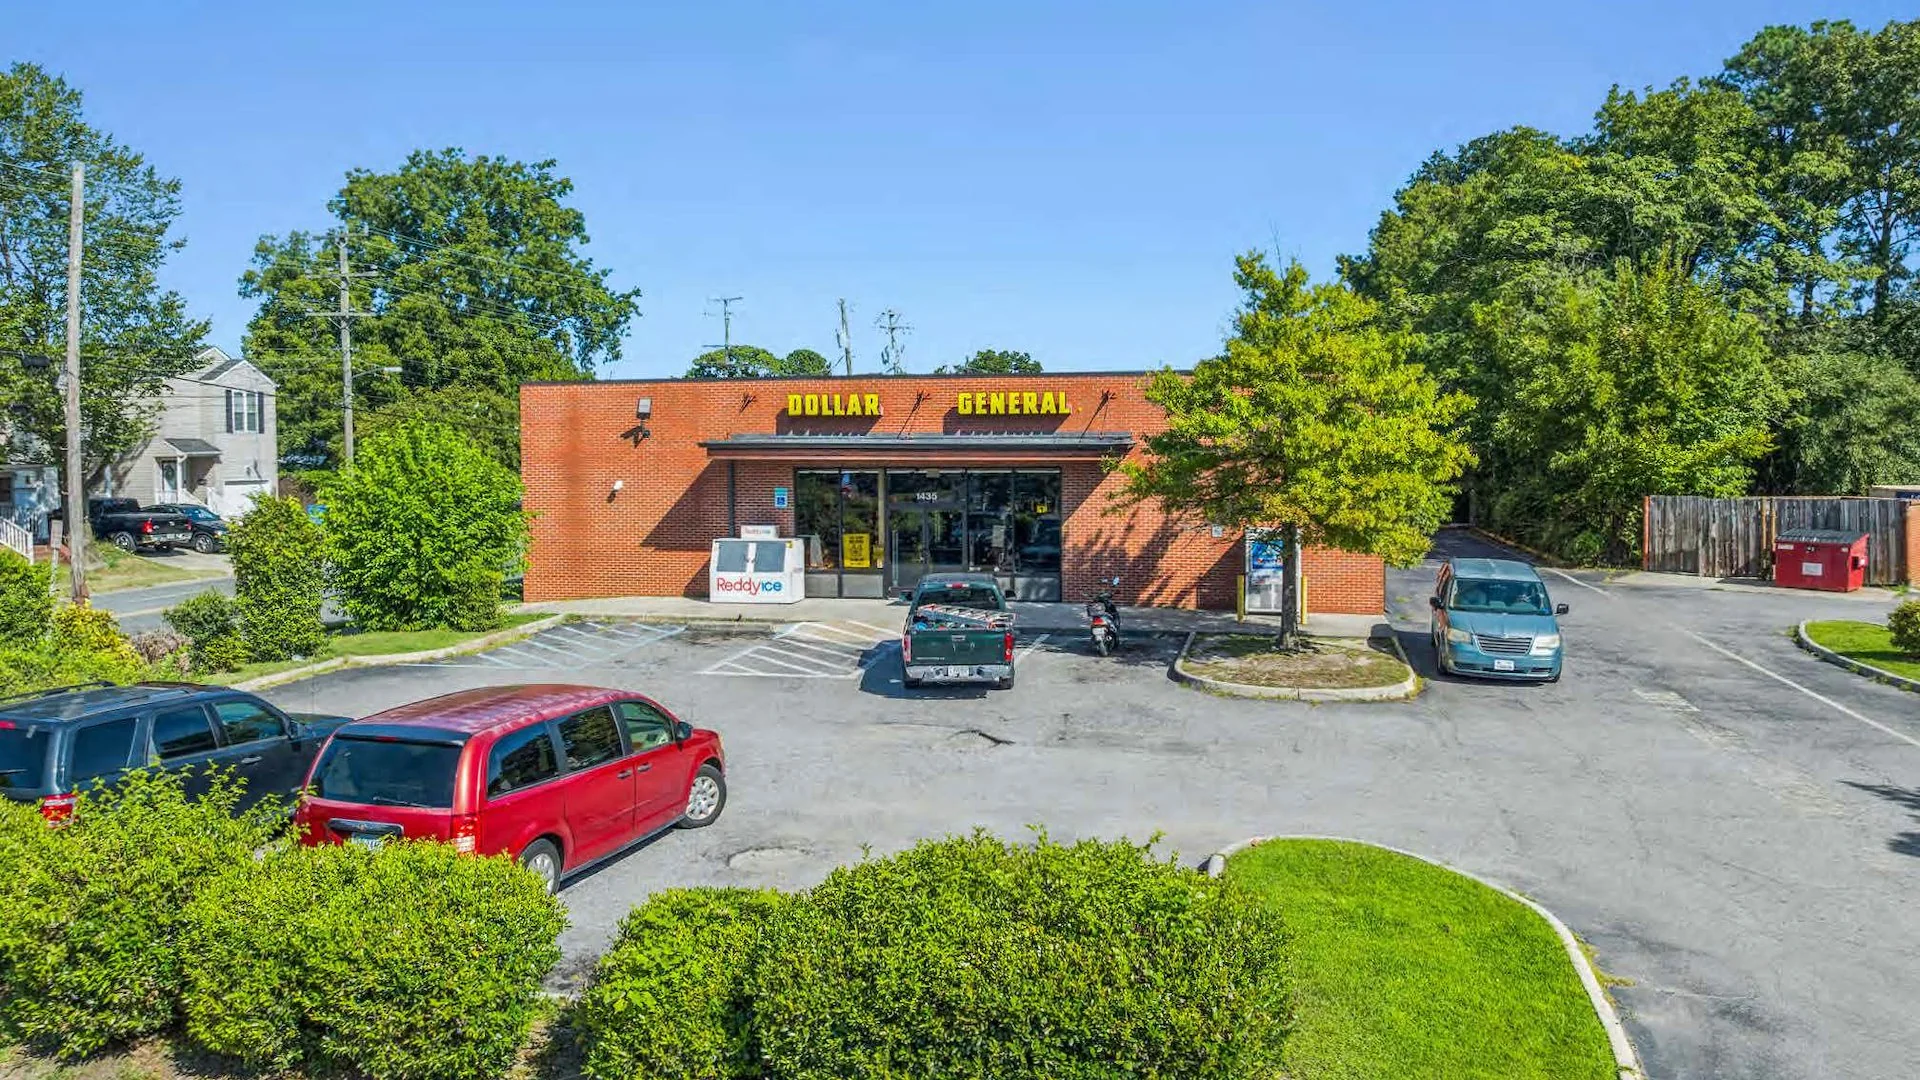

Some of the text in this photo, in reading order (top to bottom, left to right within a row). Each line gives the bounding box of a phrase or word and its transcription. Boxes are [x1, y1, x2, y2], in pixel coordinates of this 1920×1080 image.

[787, 391, 1071, 416] DOLLAR GENERAL
[916, 492, 938, 501] 1435
